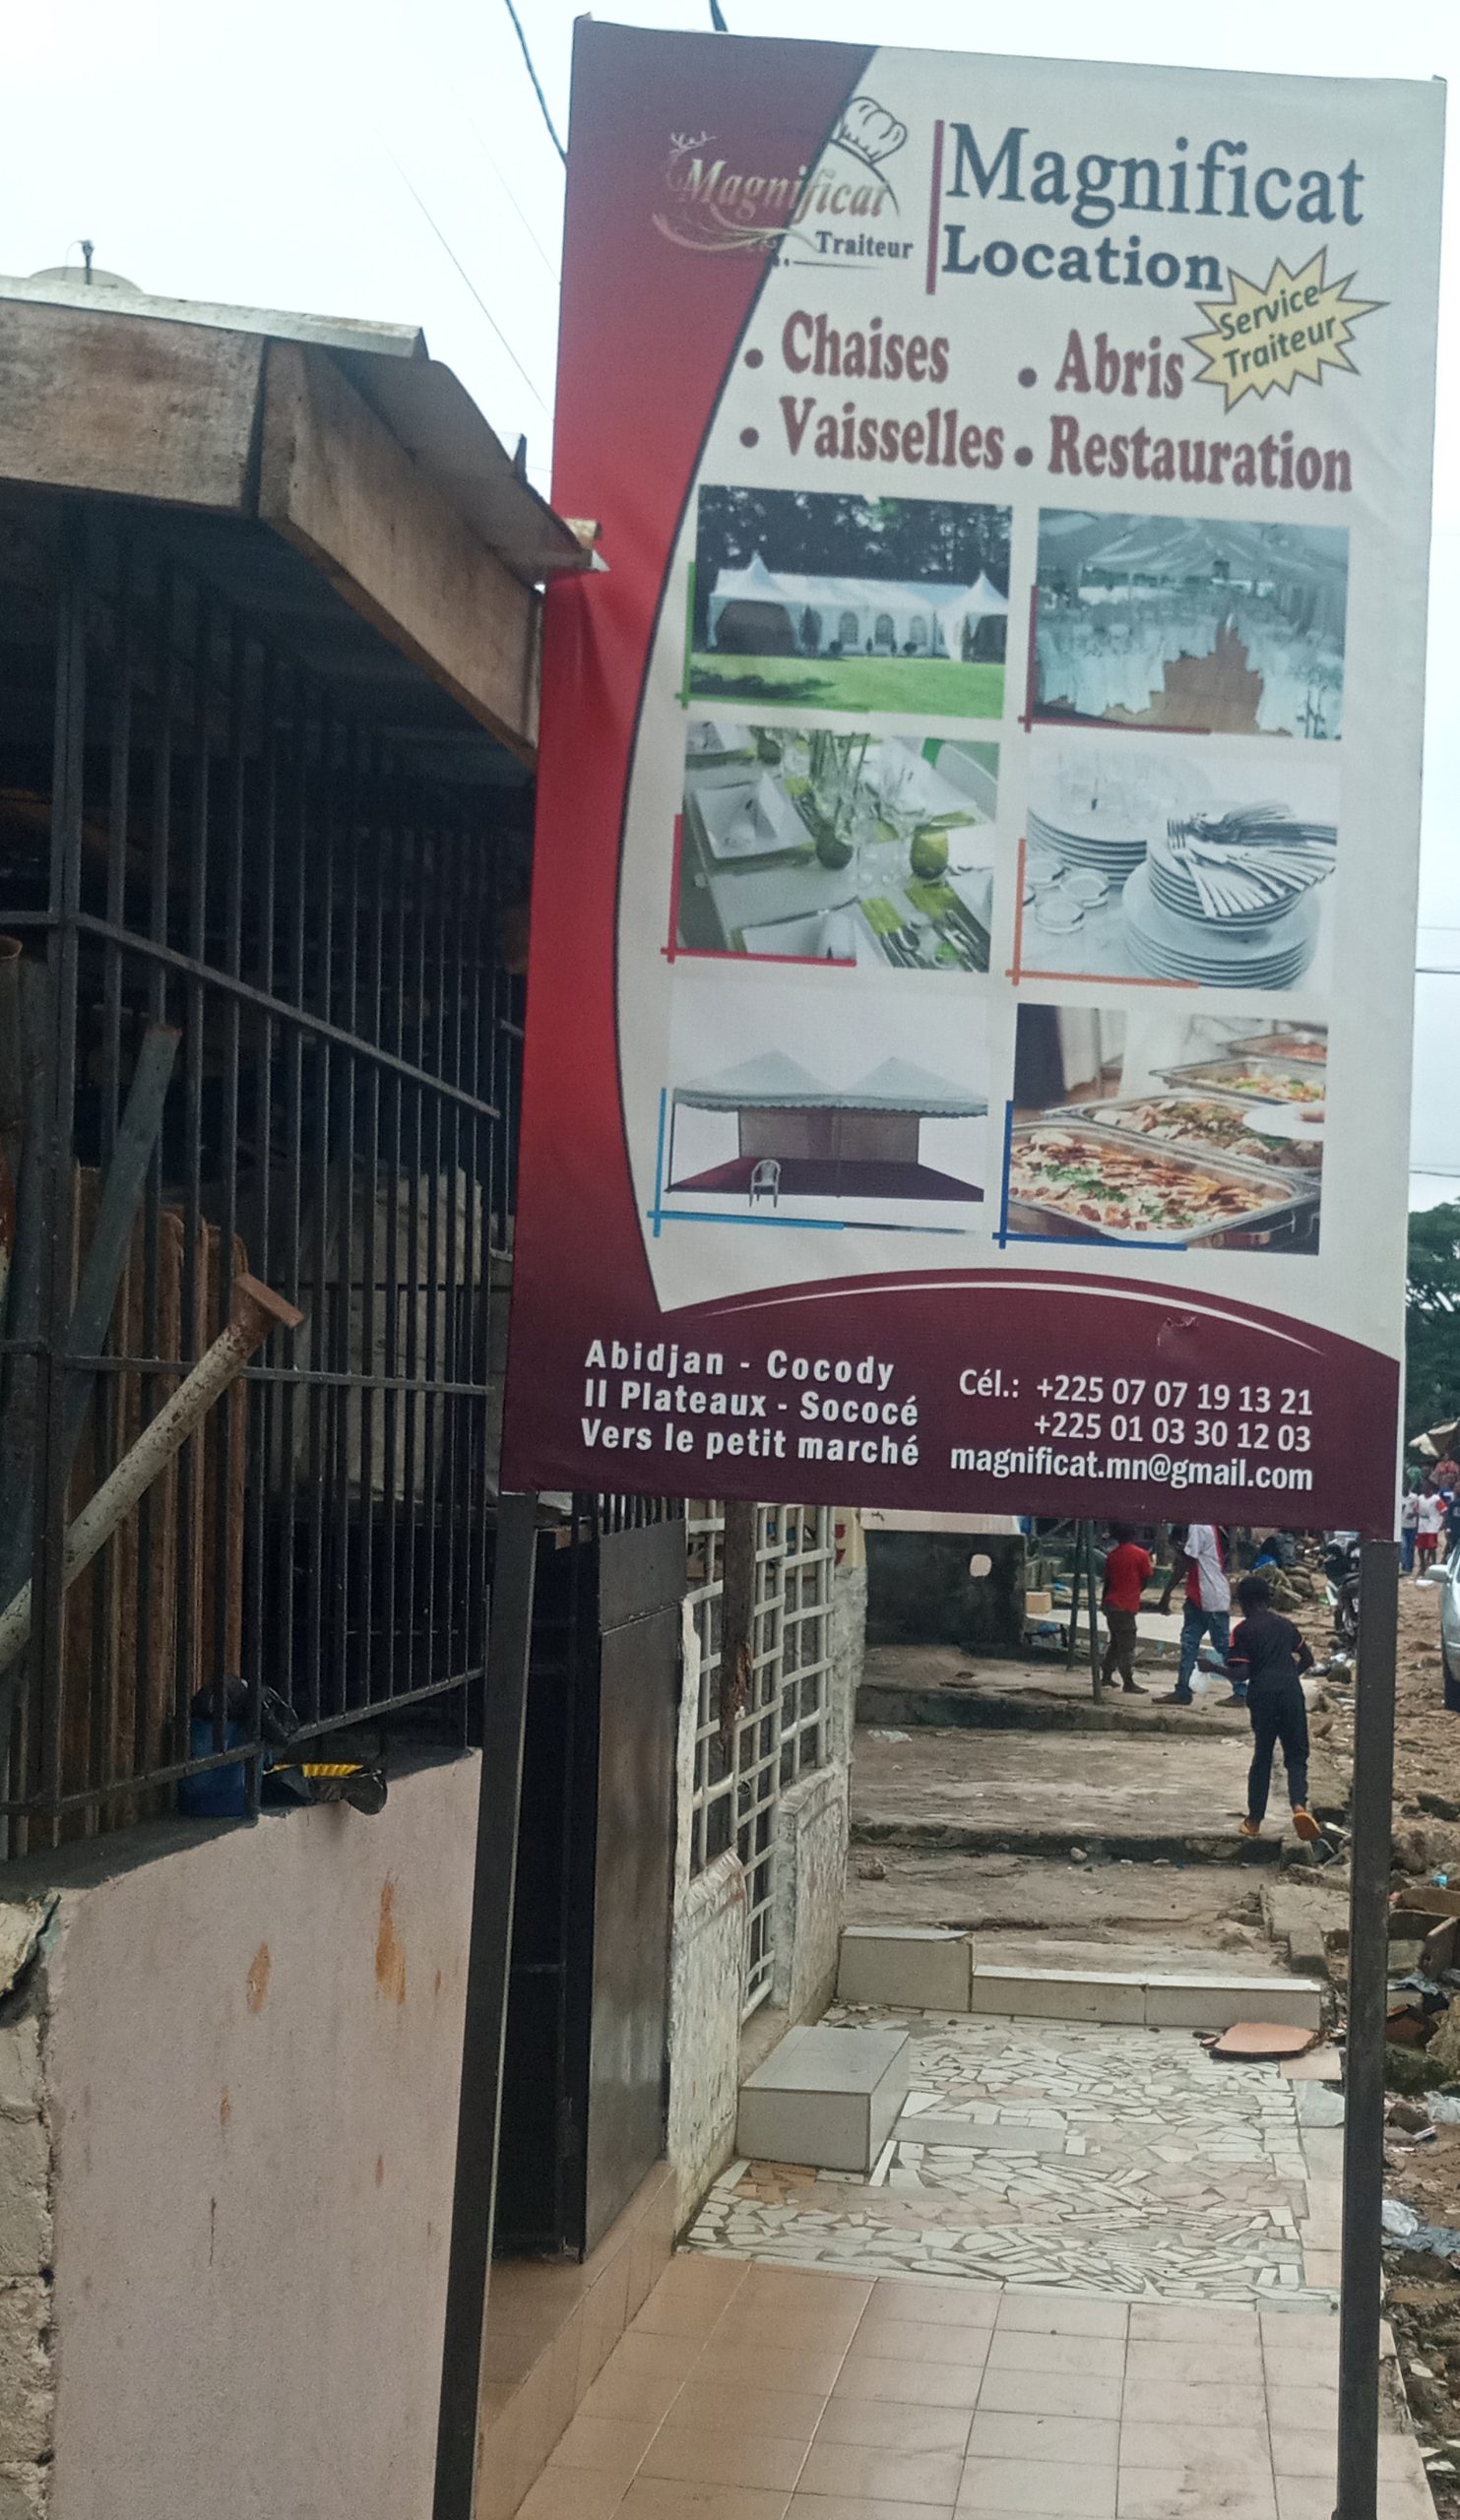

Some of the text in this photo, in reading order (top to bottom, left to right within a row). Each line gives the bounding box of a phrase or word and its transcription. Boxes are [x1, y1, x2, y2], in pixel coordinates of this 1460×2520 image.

[681, 158, 886, 224] Magnificat
[946, 122, 1365, 228] Magnificat
[815, 230, 914, 259] Traiteur
[942, 224, 1224, 292] Location
[1219, 284, 1320, 341] Service
[782, 309, 950, 384] Chaises
[1054, 328, 1183, 399] Abris
[1222, 316, 1337, 378] Traiteur
[779, 395, 1005, 471] Vaisselles
[1047, 413, 1353, 493] Restauration
[585, 1339, 725, 1378] Abidjan
[766, 1349, 895, 1391] Cocody
[959, 1367, 1313, 1416] Cél.: +225 07 07 19 13 21
[621, 1380, 767, 1418] Plateaux
[799, 1390, 919, 1426] Sococé
[1034, 1411, 1311, 1452] +225 01 03 30 12 03
[581, 1418, 920, 1466] Vers le petit marché
[950, 1446, 1313, 1490] magnificat.mn@gmail.com
